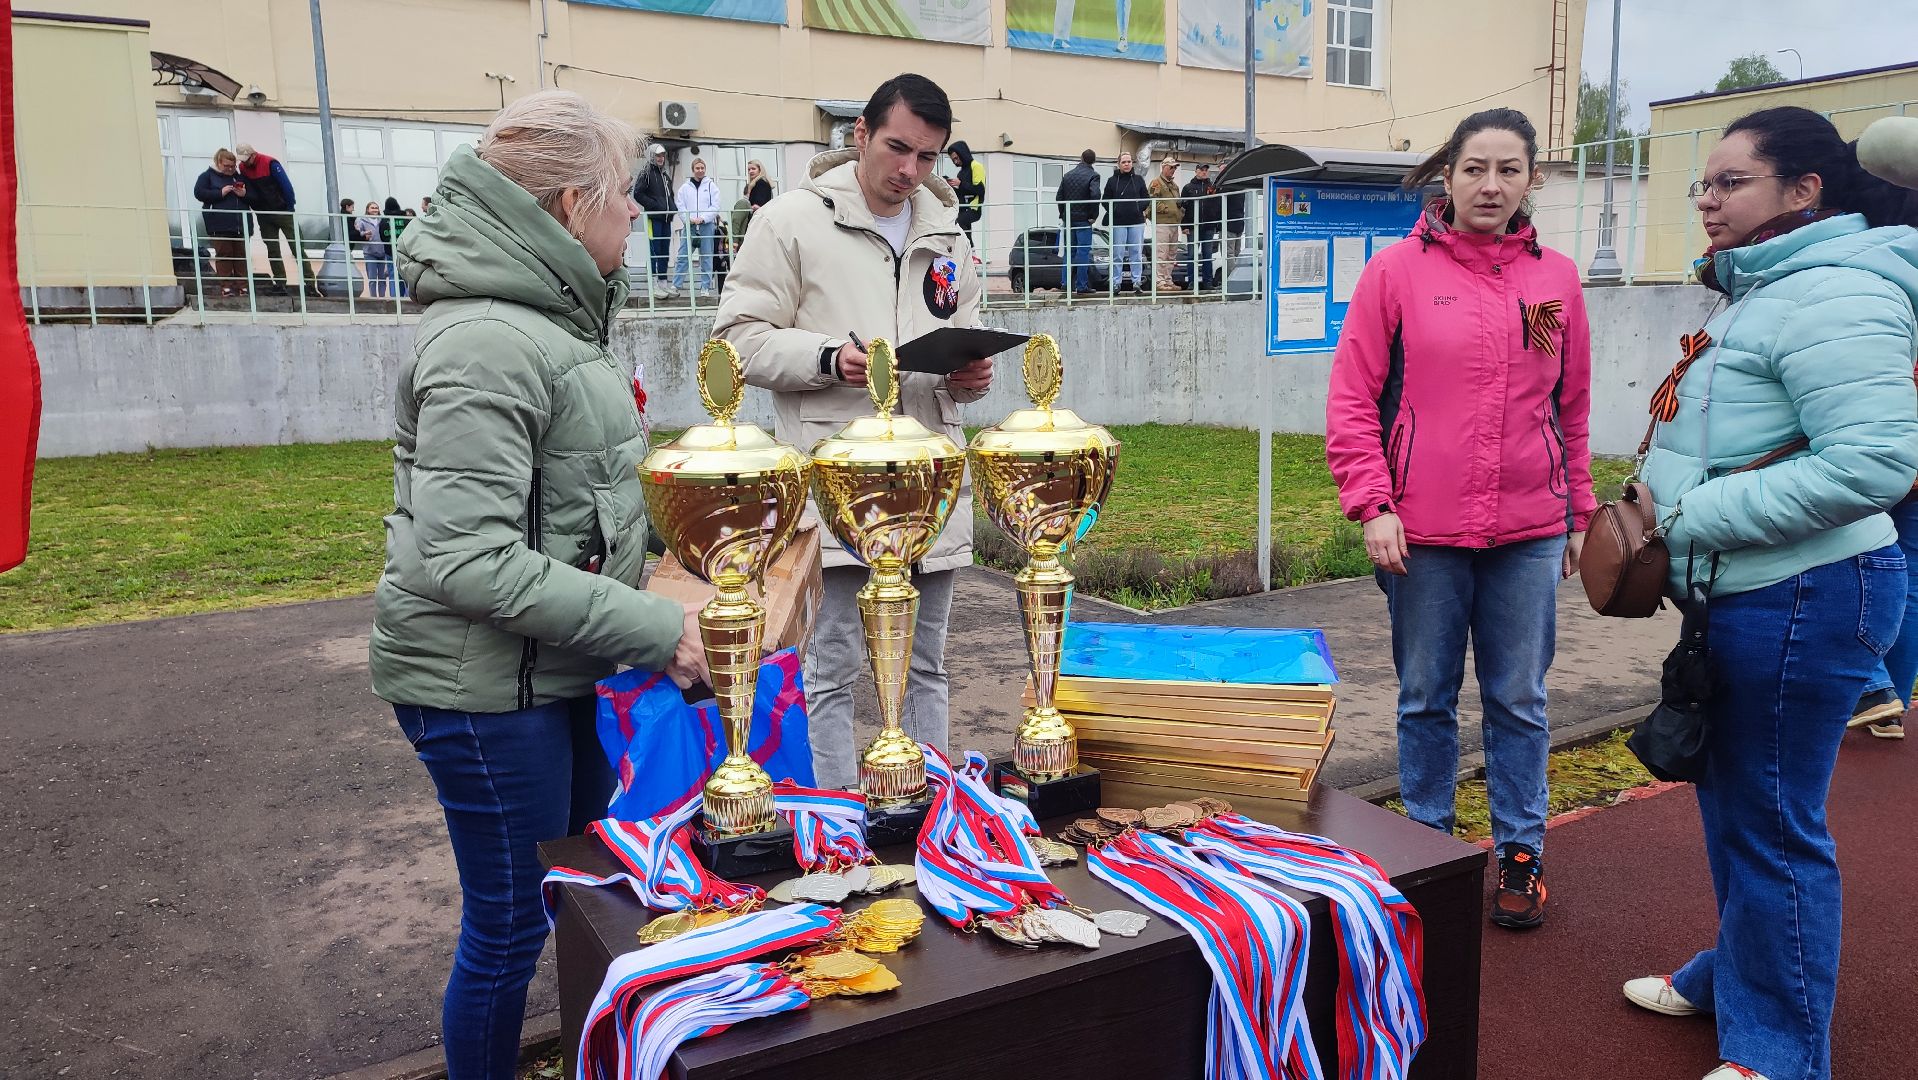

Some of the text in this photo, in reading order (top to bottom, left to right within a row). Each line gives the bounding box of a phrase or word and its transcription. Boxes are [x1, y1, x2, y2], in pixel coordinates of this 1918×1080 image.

[1316, 189, 1361, 201] Теннисные
[1362, 192, 1386, 203] корты
[1404, 192, 1417, 202] №2
